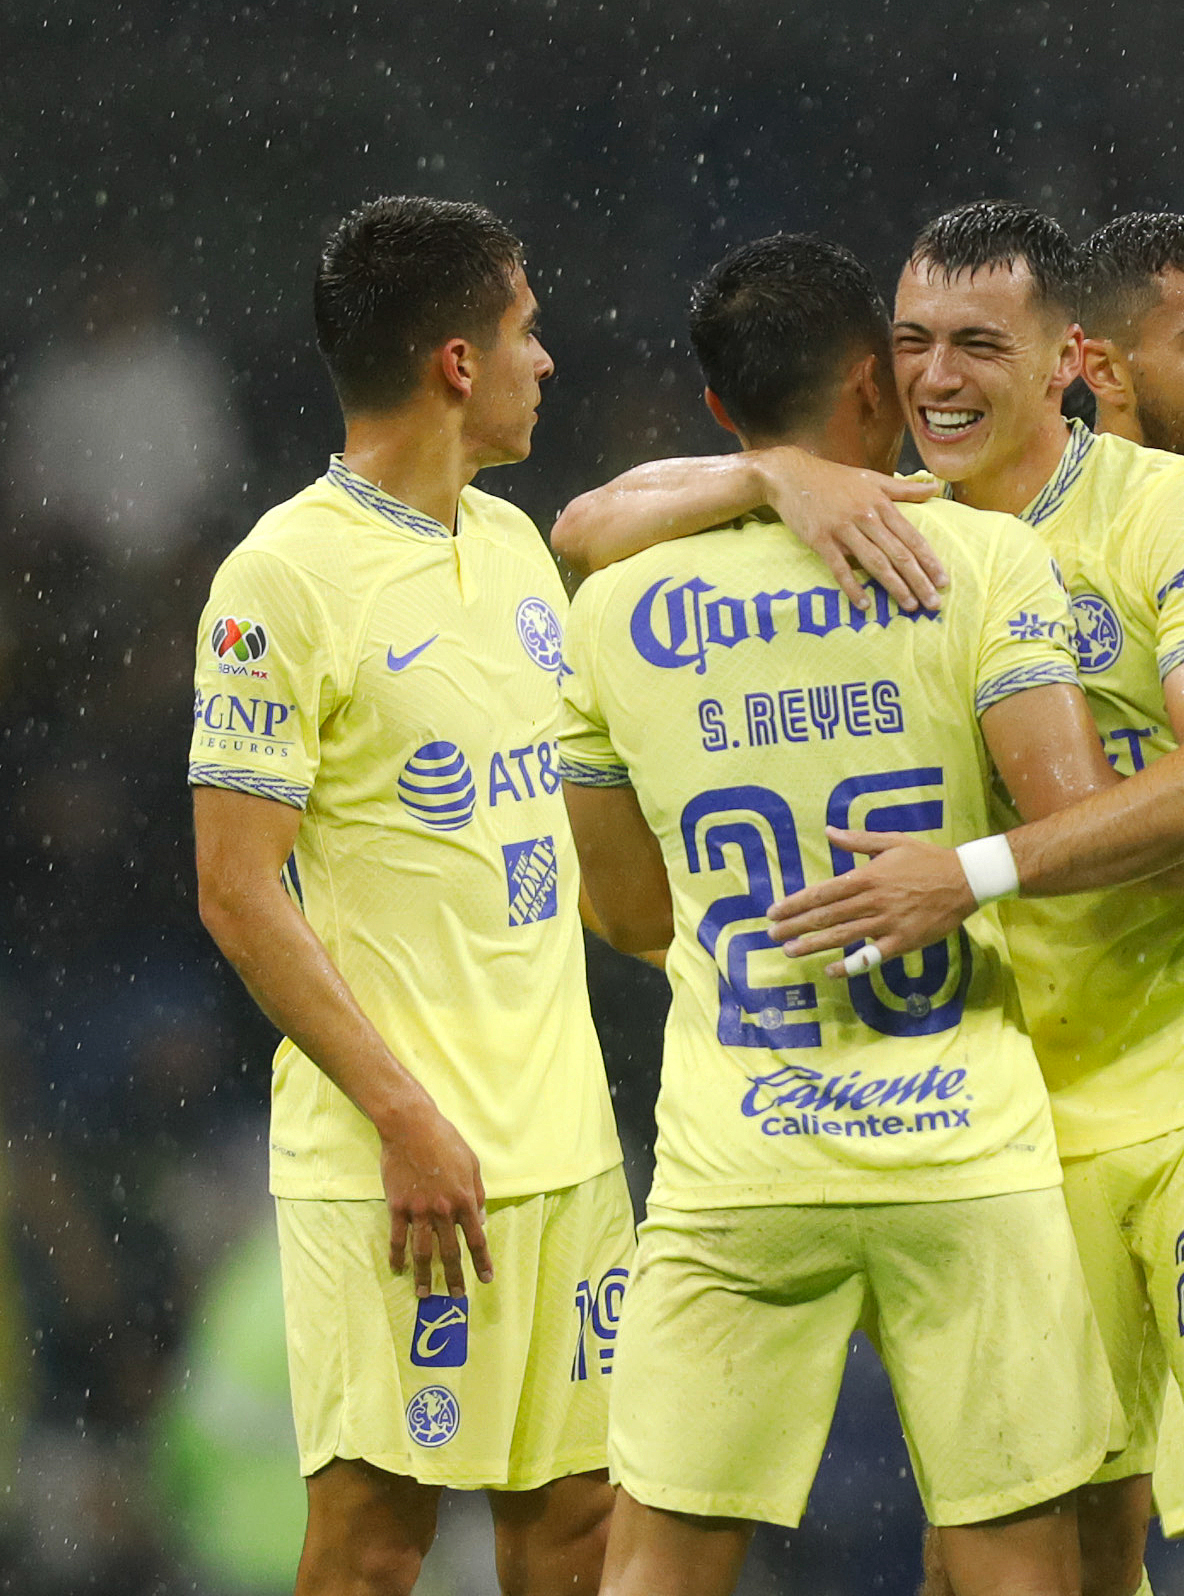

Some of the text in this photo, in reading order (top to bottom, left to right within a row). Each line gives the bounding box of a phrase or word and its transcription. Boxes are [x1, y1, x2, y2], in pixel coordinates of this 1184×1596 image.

[629, 576, 943, 675] Coron
[489, 741, 561, 807] AT&
[741, 1065, 967, 1117] Caliente
[761, 1108, 972, 1138] caliente.mx
[570, 1267, 629, 1382] 19
